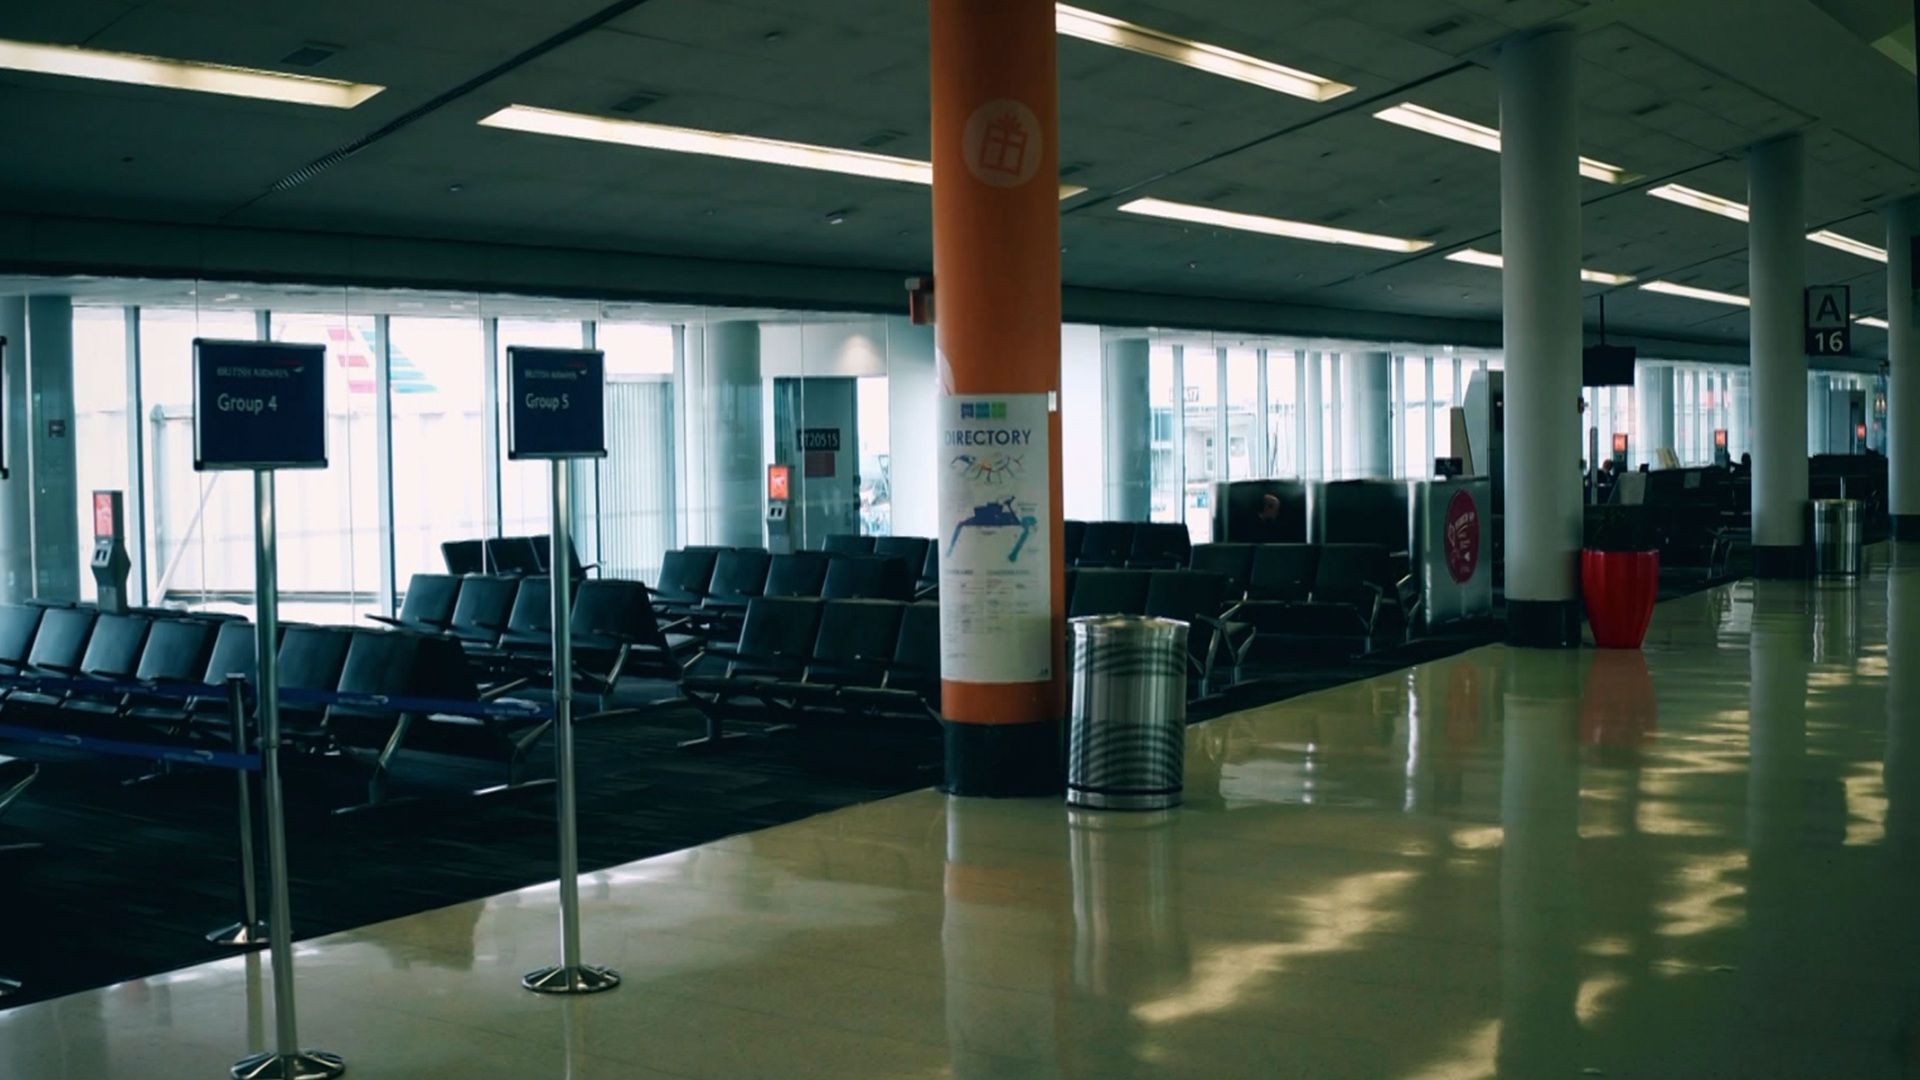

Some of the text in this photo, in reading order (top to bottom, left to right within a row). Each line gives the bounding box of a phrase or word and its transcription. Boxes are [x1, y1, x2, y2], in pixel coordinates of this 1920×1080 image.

[1815, 294, 1842, 322] A
[1815, 331, 1844, 352] 16
[217, 392, 278, 415] Group 4
[525, 392, 570, 412] Group 5
[945, 430, 1031, 446] DIRECTORY
